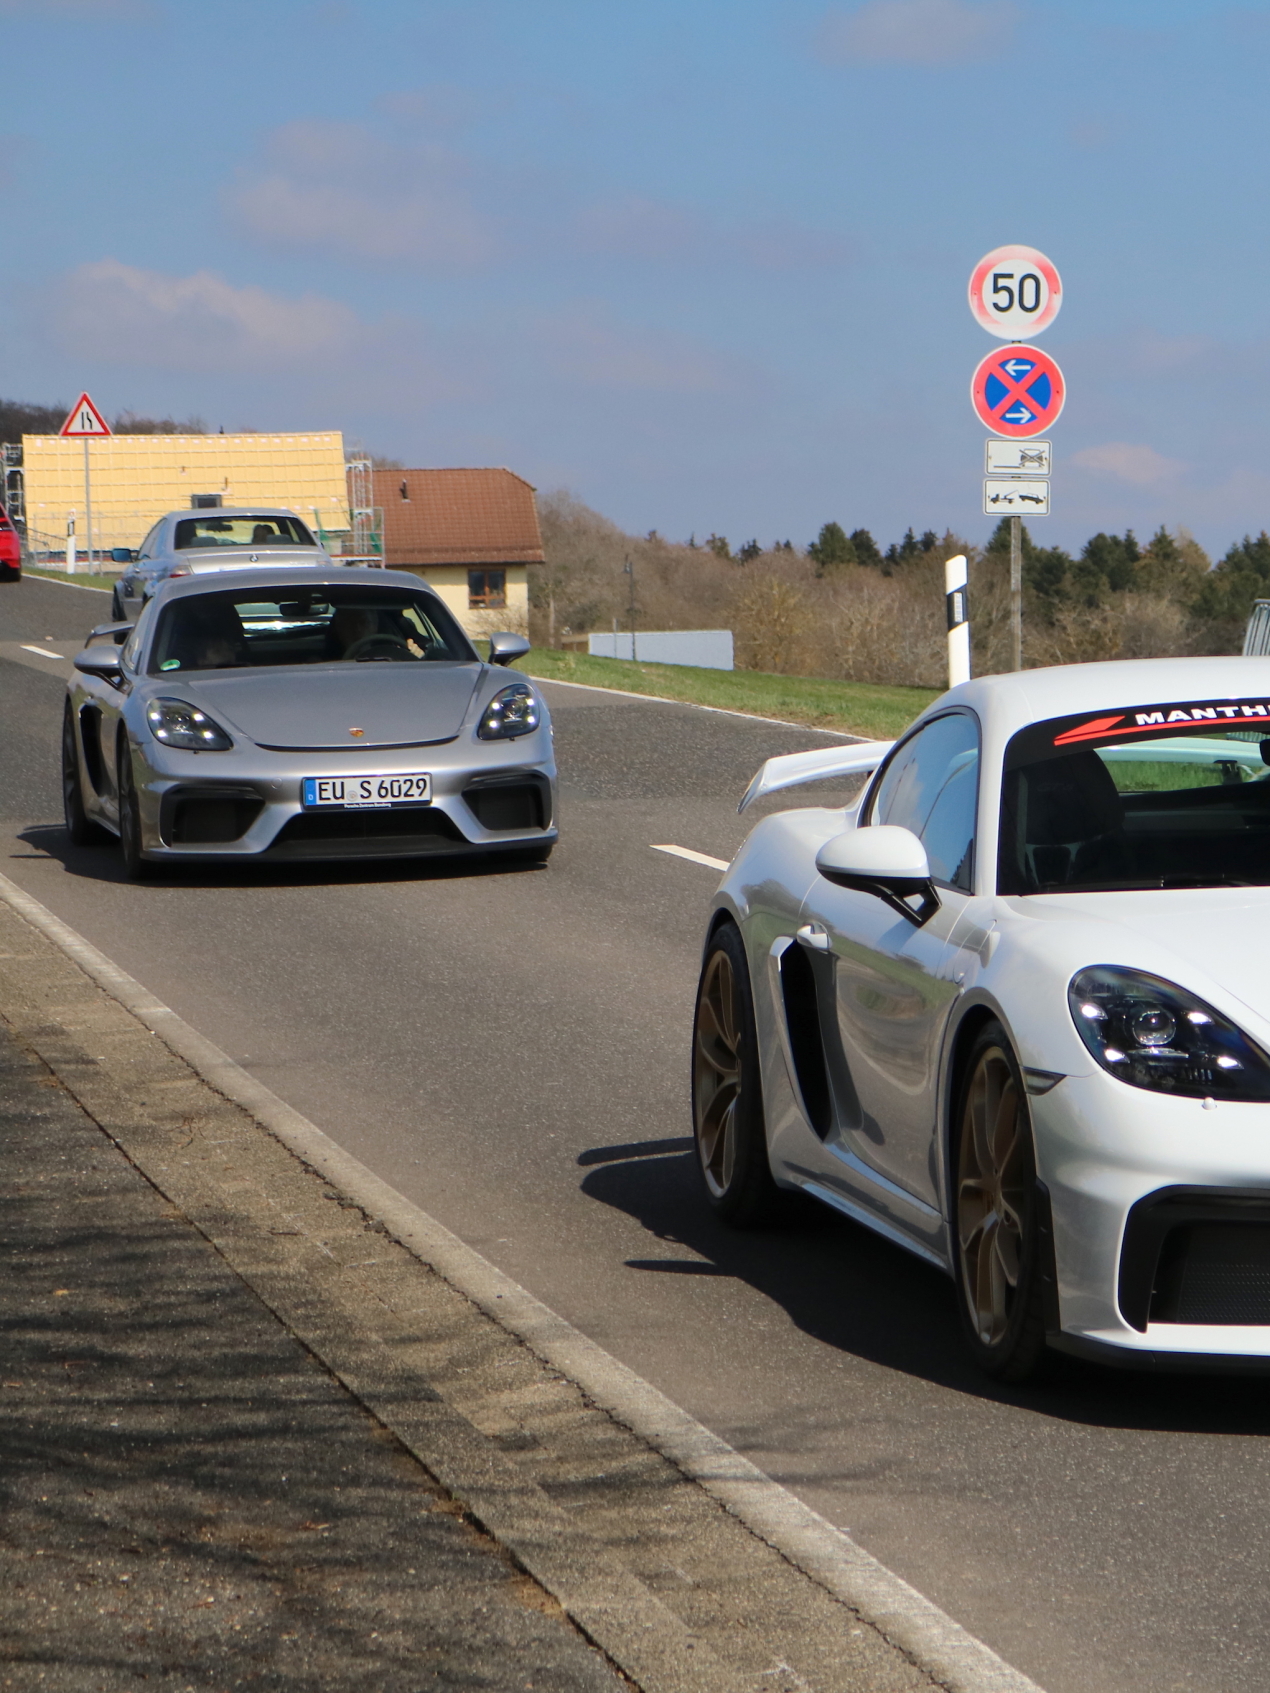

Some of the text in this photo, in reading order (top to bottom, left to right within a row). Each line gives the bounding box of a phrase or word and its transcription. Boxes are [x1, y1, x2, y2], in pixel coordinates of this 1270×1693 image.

[992, 273, 1041, 313] 50
[318, 777, 427, 801] EU S 6029
